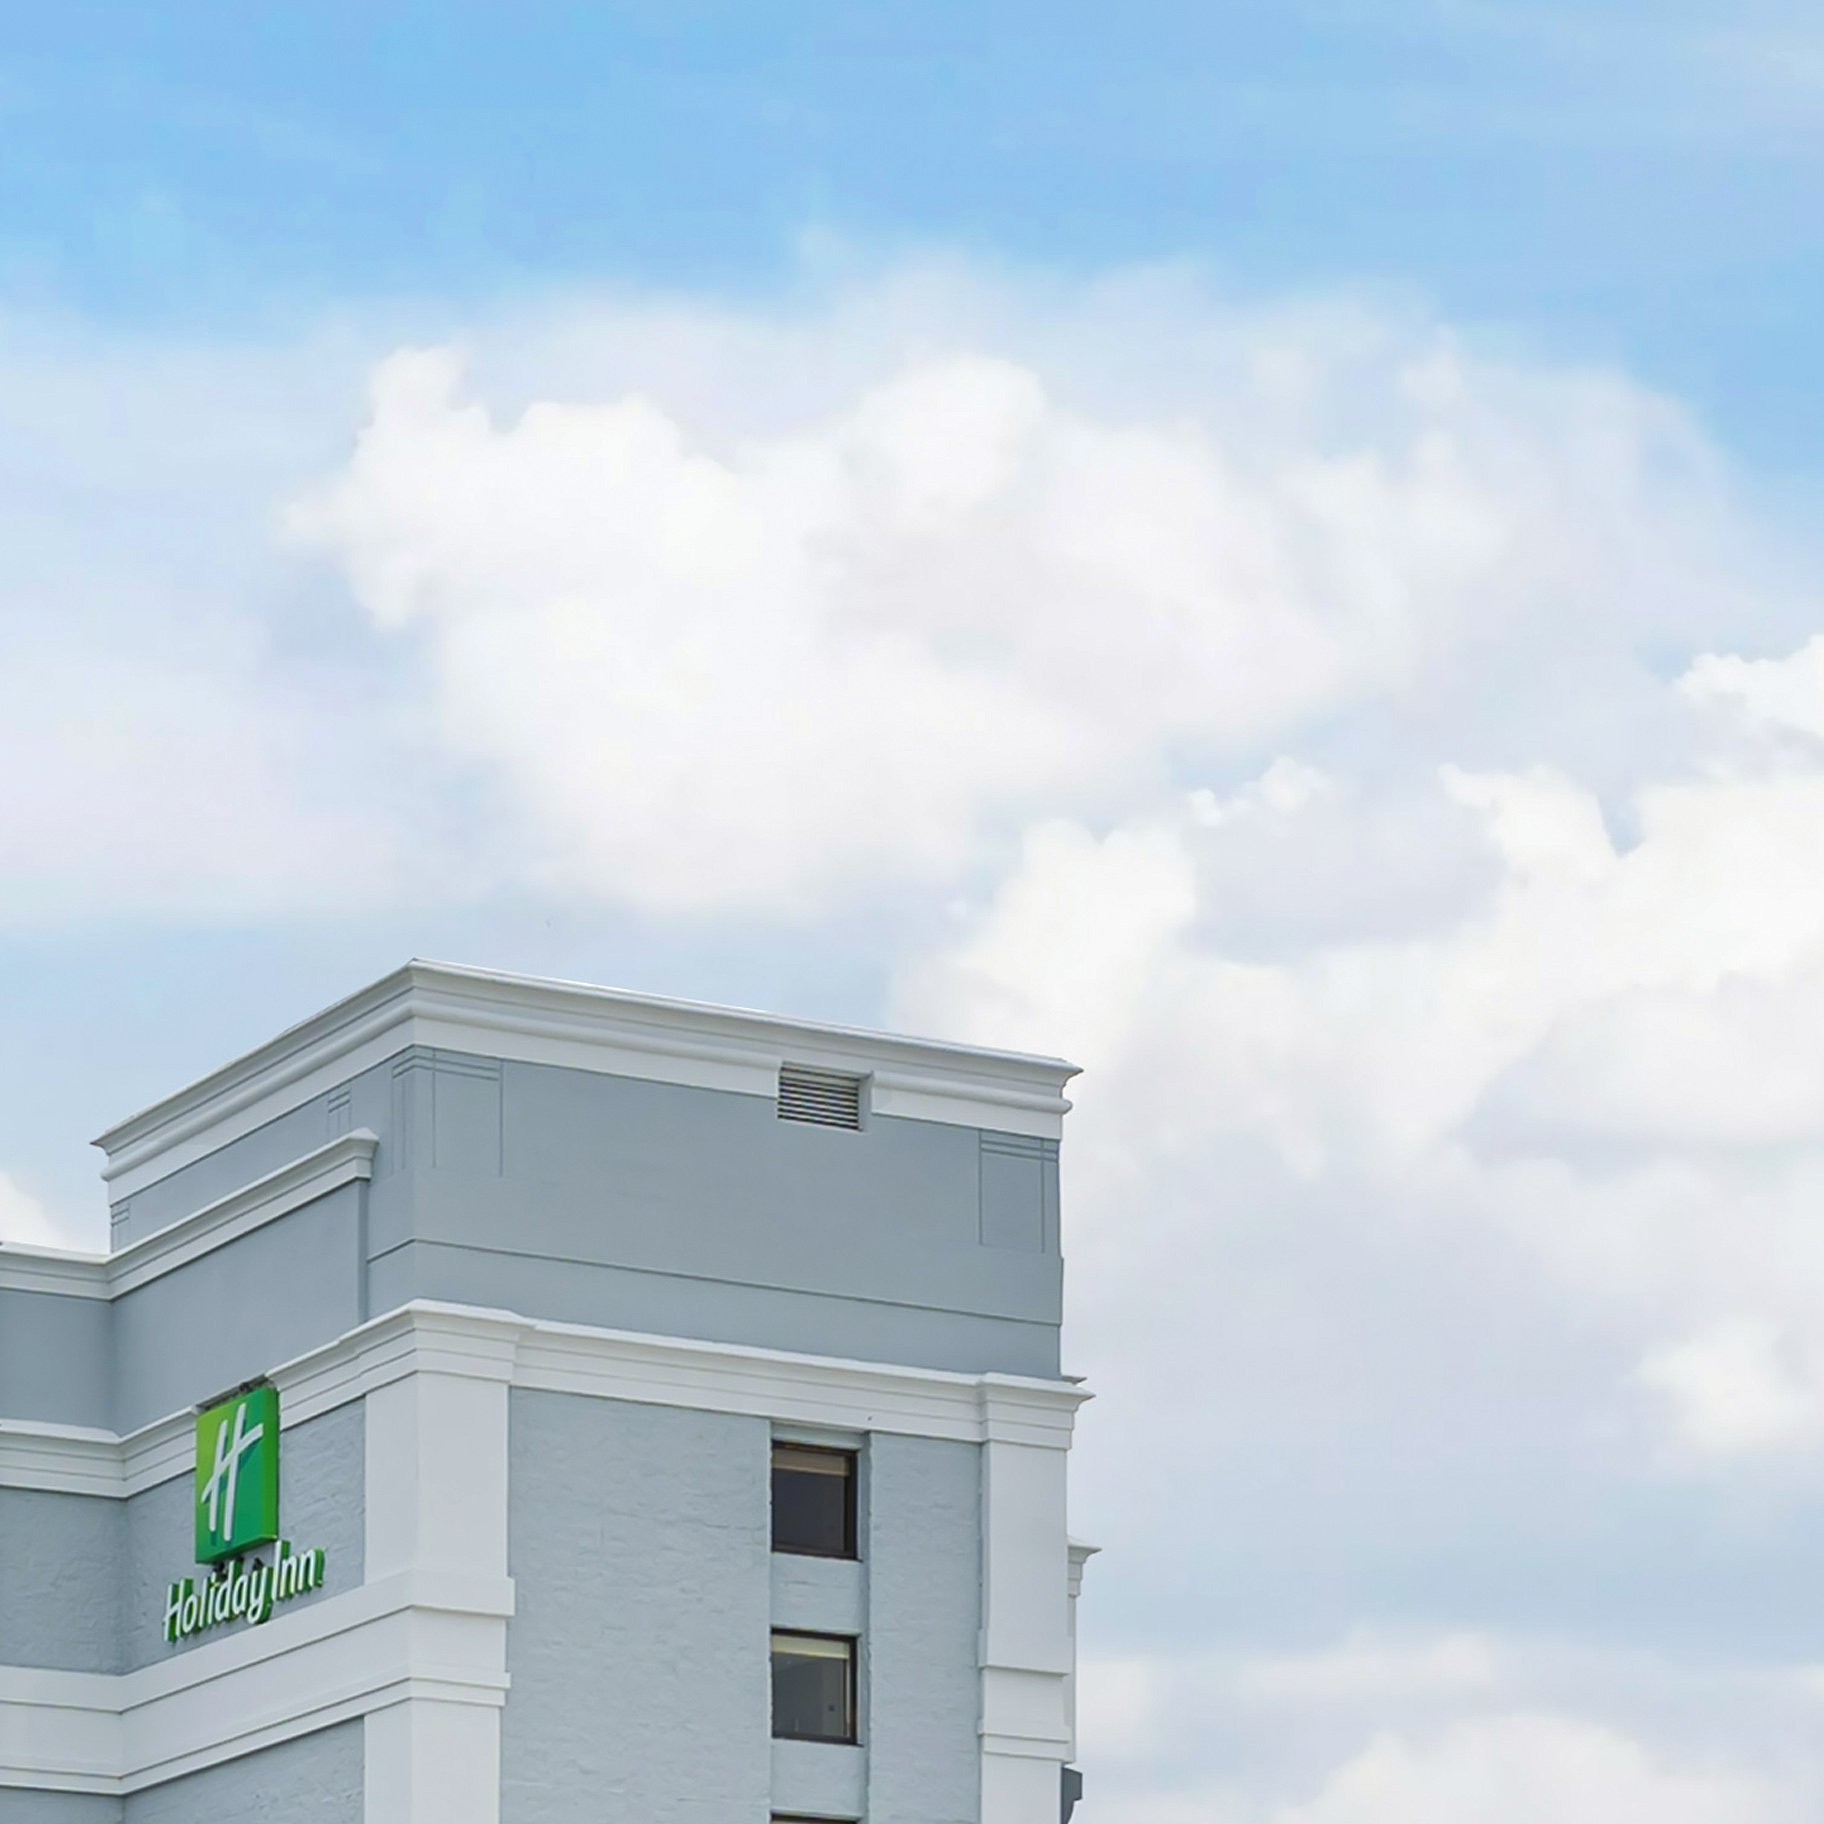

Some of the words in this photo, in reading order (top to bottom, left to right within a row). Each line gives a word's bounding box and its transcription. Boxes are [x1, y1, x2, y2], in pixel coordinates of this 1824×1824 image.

[200, 1402, 265, 1542] H
[163, 1559, 272, 1643] Holiday
[271, 1539, 325, 1602] Inn
